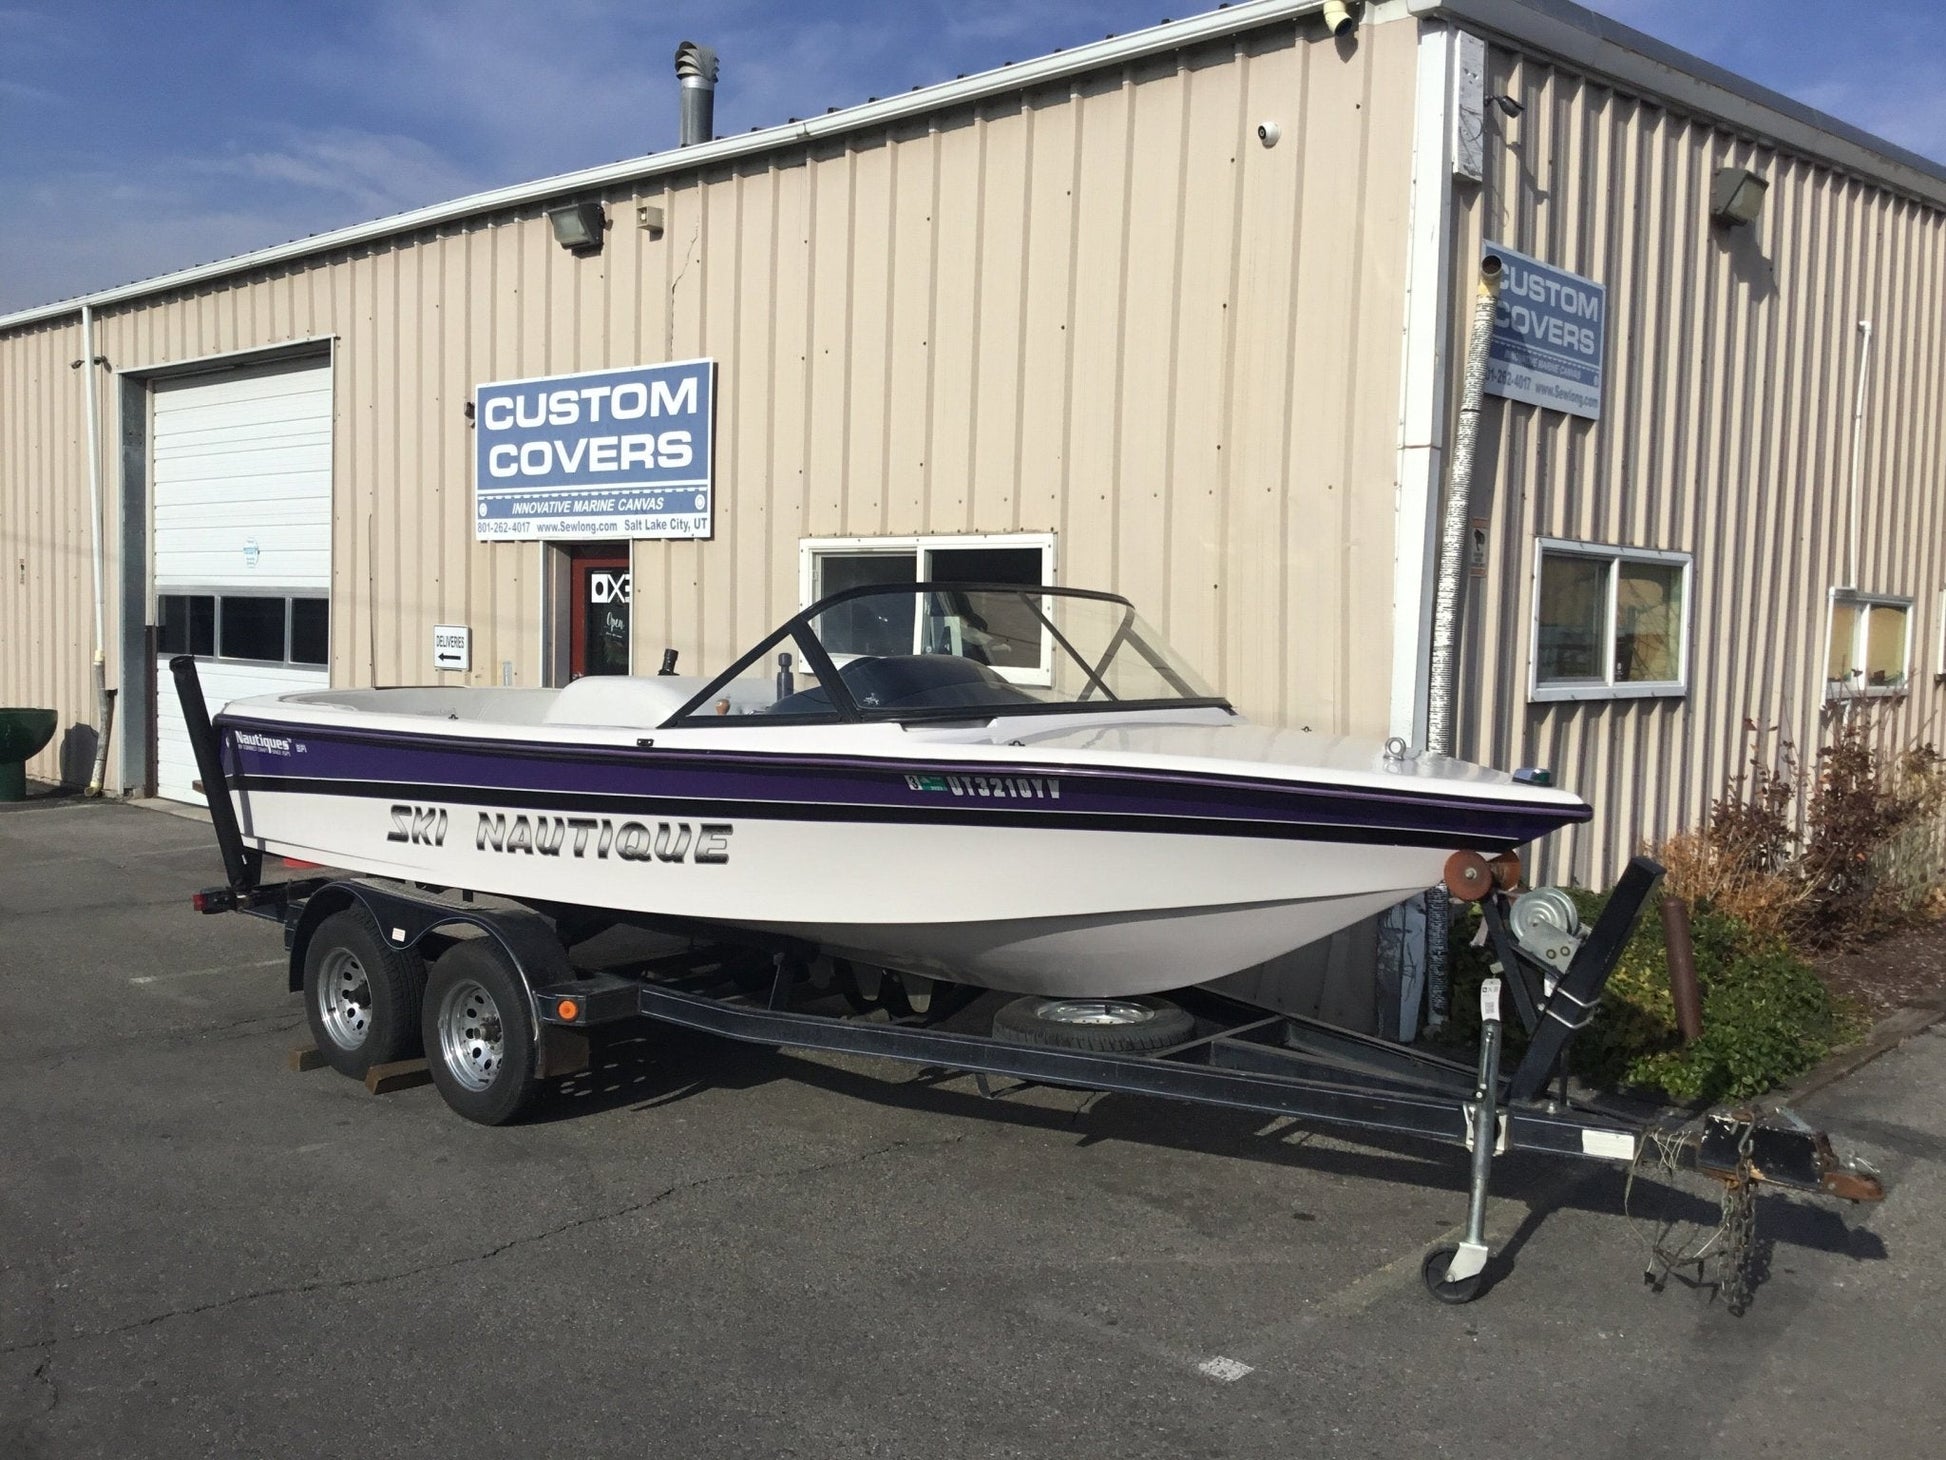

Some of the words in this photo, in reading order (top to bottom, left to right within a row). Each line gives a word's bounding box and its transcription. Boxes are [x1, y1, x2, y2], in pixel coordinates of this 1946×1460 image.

[1500, 263, 1598, 322] CUSTOM
[1495, 301, 1594, 354] COVERS
[485, 377, 697, 430] CUSTOM
[489, 431, 693, 478] COVERS
[477, 521, 531, 533] 801-262-4017
[536, 521, 618, 535] www.Sewlong.com
[624, 519, 642, 531] Salt
[645, 518, 667, 531] Lake
[670, 518, 691, 533] City,
[694, 517, 707, 530] UT
[512, 501, 572, 514] INNOVATIVE
[573, 499, 615, 513] MARINE
[618, 497, 664, 511] CANVAS
[436, 635, 465, 649] DELIVERIES
[235, 730, 290, 754] Nautiques
[387, 804, 449, 847] SKI
[476, 811, 734, 865] NAUTIQUE
